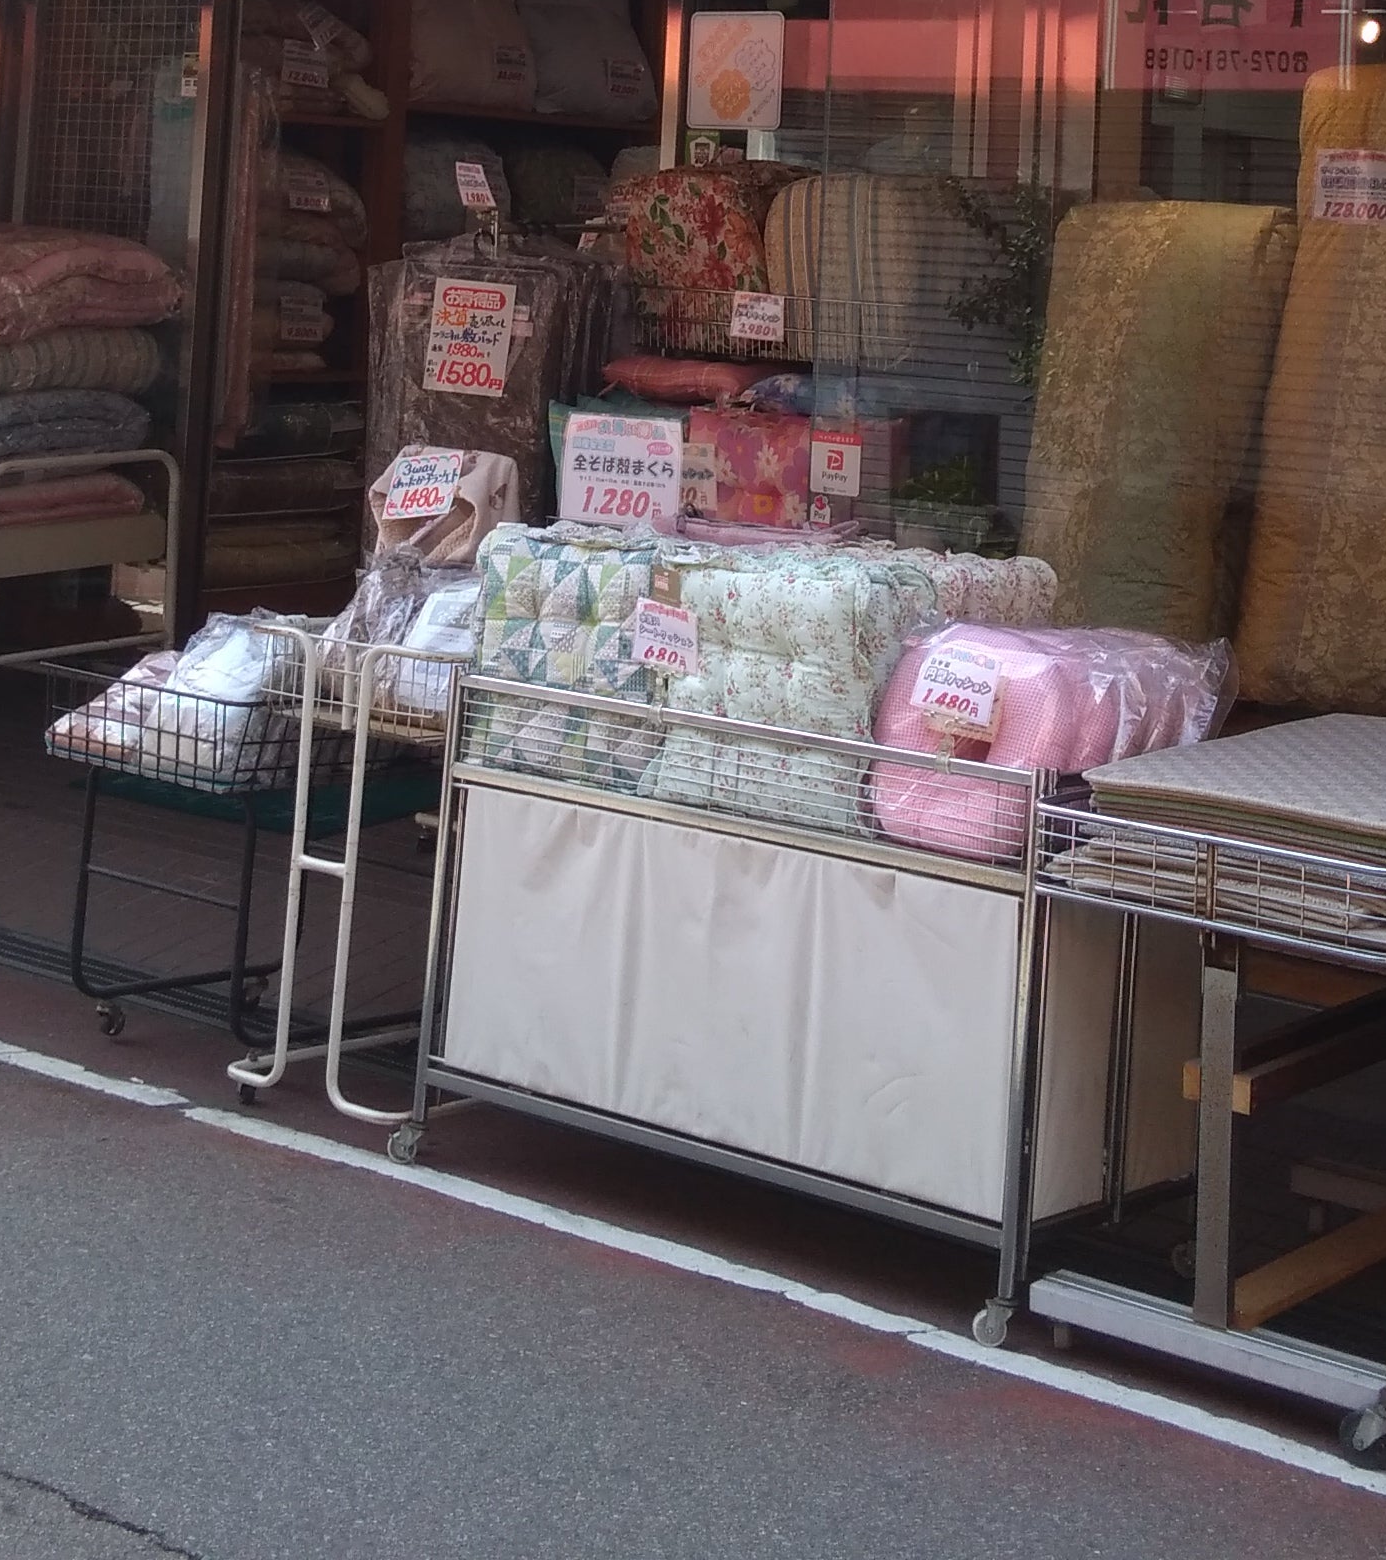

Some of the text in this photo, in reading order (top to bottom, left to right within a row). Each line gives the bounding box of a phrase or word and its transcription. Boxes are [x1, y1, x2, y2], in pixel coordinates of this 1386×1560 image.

[573, 454, 674, 479] 全そば殻まくら
[821, 470, 849, 483] PayPay
